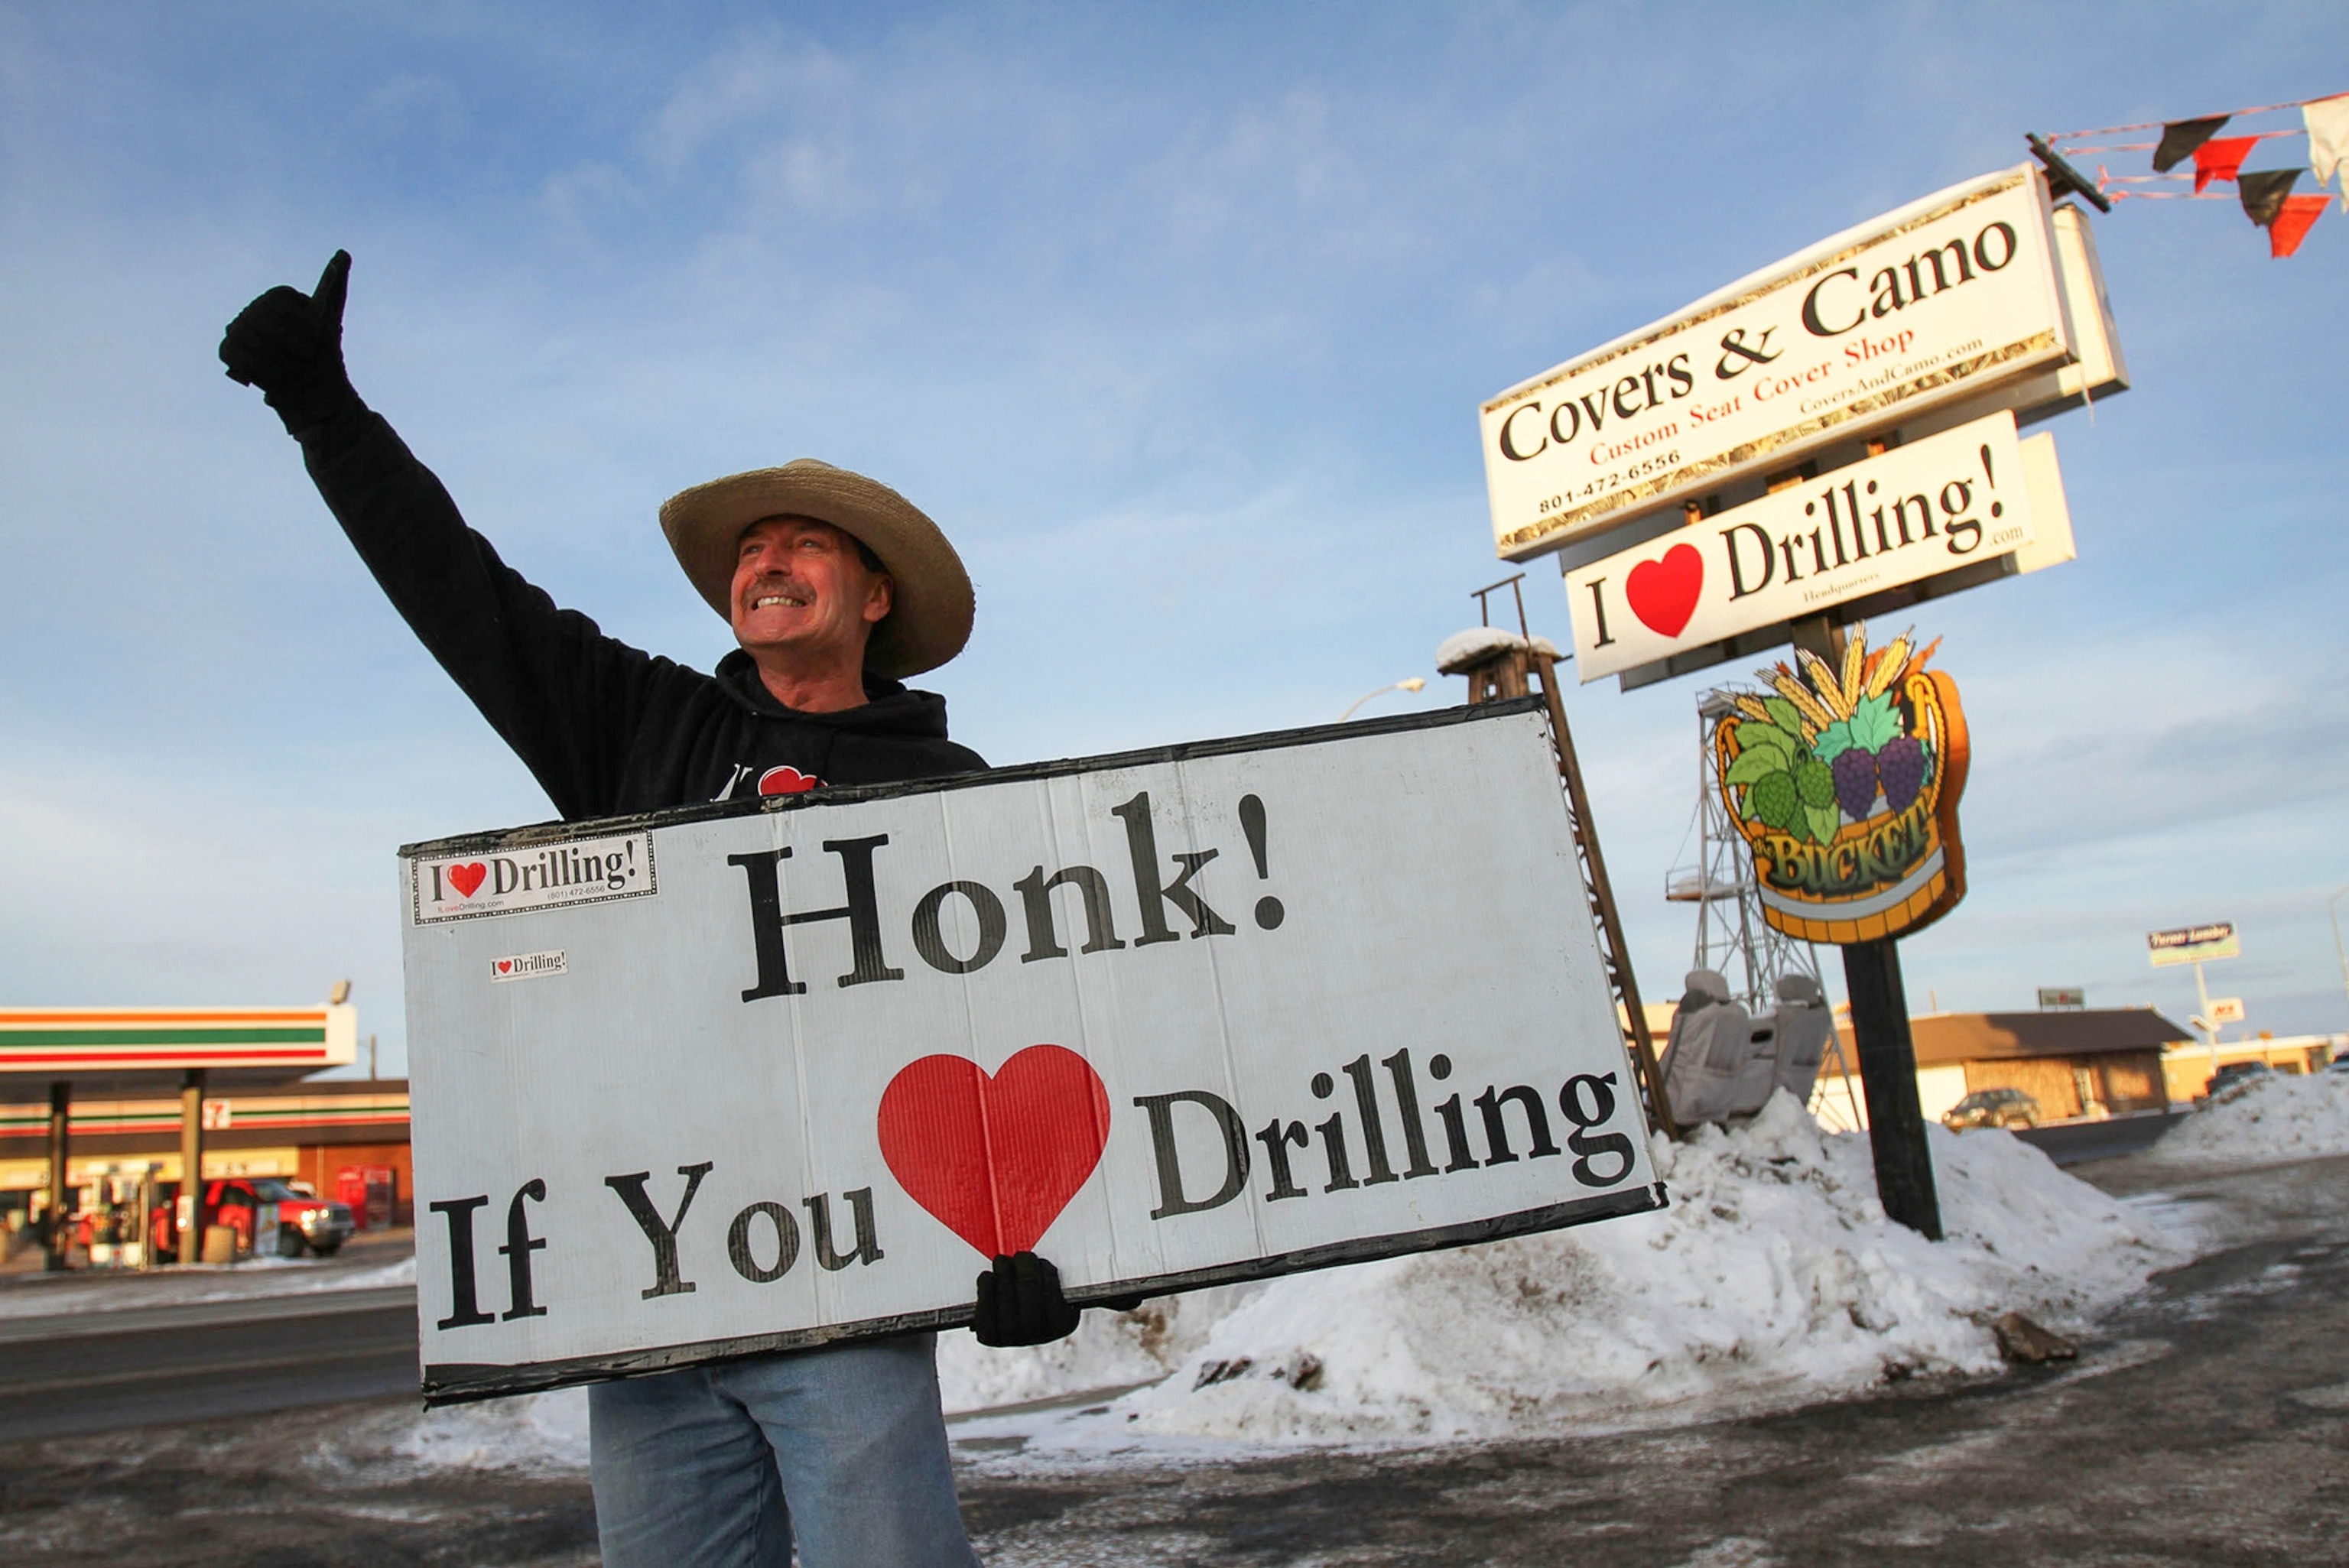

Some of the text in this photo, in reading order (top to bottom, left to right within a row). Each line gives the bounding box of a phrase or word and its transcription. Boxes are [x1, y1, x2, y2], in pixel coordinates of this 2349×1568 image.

[1499, 221, 2017, 462] Covers & Camo
[1800, 337, 1984, 414] CoversAndCamo.com
[1590, 328, 1915, 466] Custom Seat Cover Shop
[1538, 450, 1681, 514] 801-472-6556
[1585, 443, 2003, 650] I Drilling!
[1989, 524, 2024, 548] .com
[1802, 571, 1881, 604] Headquarters
[430, 839, 636, 902] I Drilling!
[1767, 797, 1932, 896] BUCKET
[569, 885, 606, 898] 472-6556
[727, 790, 1285, 1004] Honk!
[491, 950, 566, 976] I Drilling!
[429, 1047, 1636, 1331] If You Drilling
